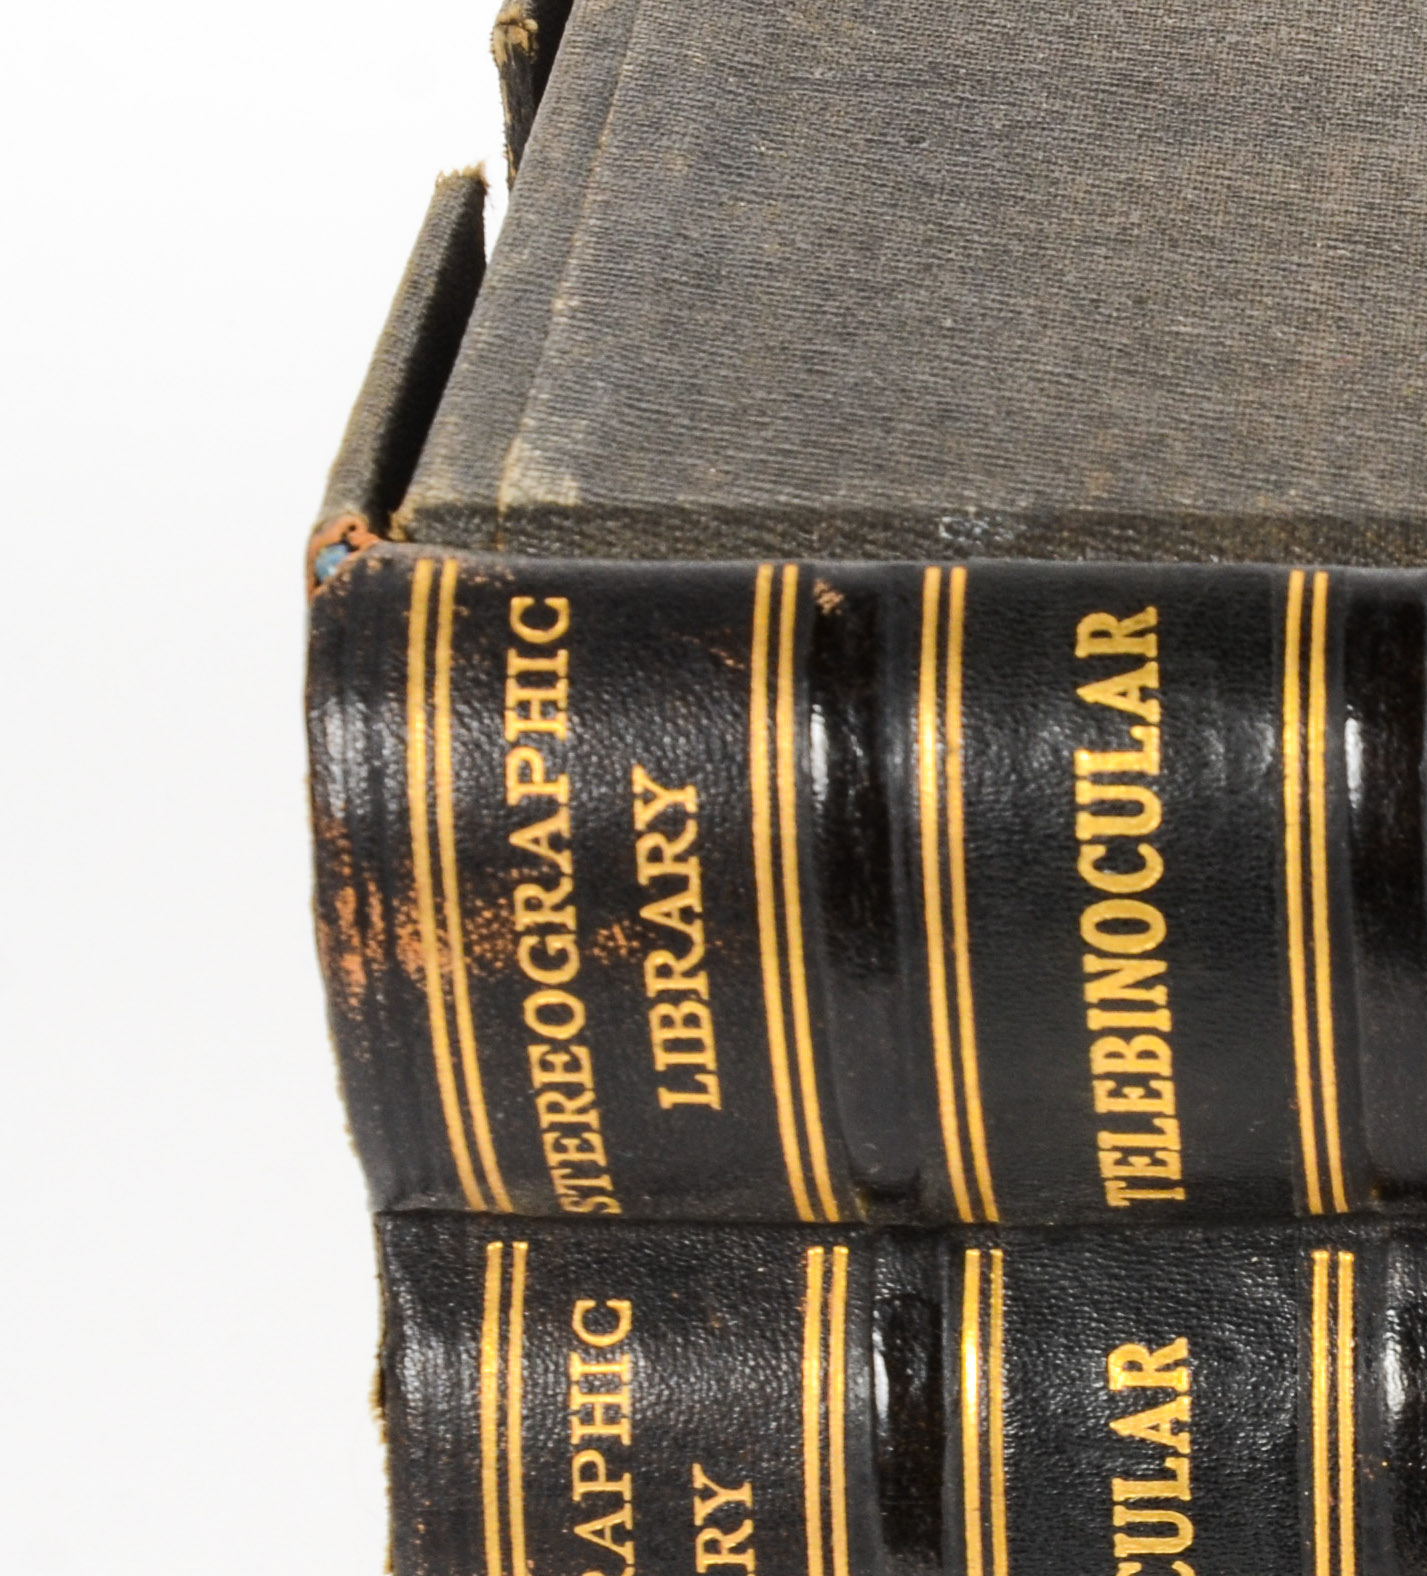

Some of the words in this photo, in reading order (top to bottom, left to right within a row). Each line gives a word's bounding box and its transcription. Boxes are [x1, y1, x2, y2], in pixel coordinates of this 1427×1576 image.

[504, 596, 624, 1214] STEREOGRAPHIC
[632, 765, 721, 1110] LIBRARY
[1074, 606, 1187, 1206] TELEBINOCULAR
